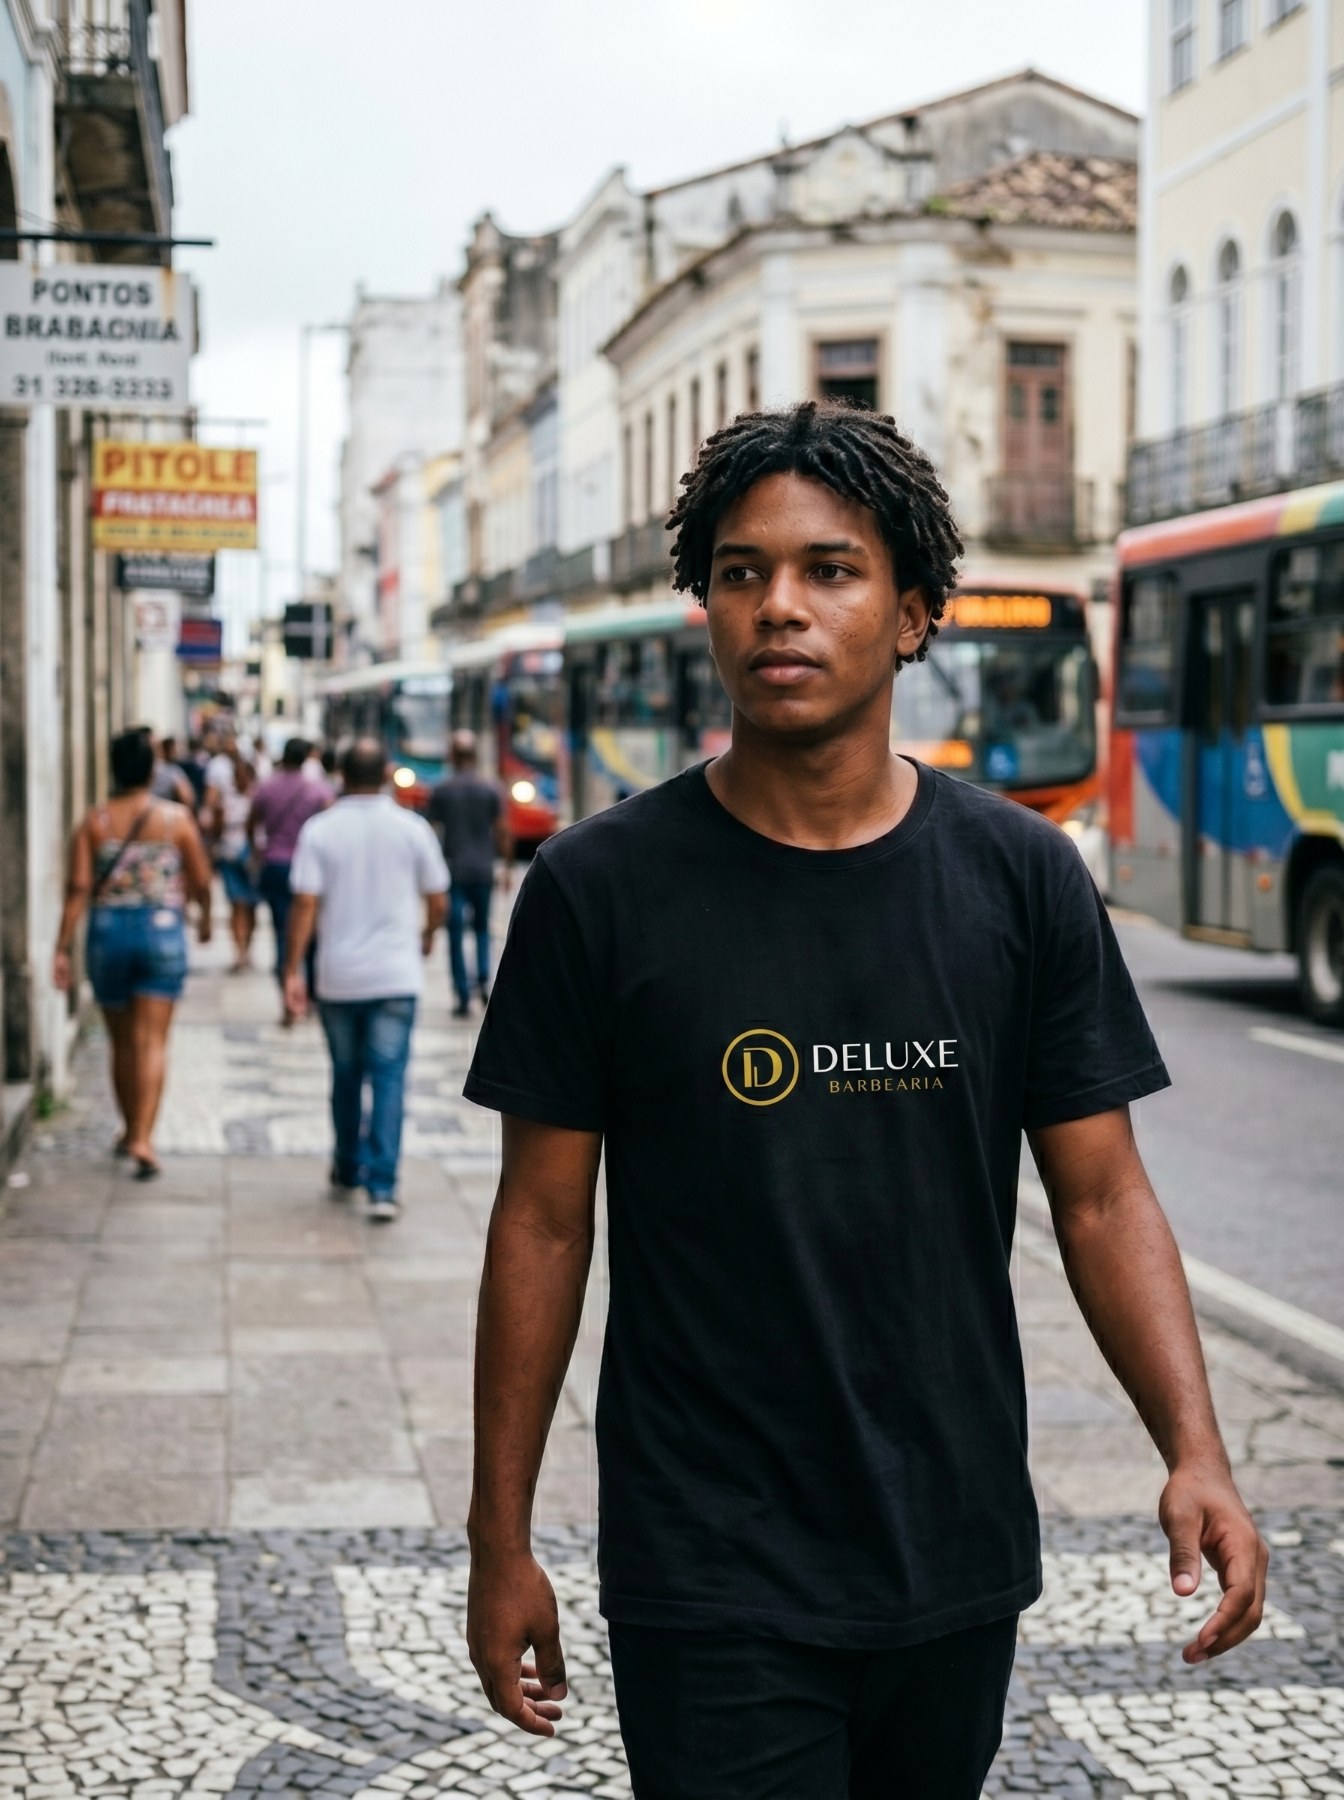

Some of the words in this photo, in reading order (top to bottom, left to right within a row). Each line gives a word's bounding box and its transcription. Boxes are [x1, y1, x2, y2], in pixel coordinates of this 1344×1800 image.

[32, 279, 152, 307] PONTOS
[103, 449, 250, 483] PITOLE
[812, 1039, 959, 1073] DELUXE
[829, 1076, 944, 1094] BARBEARIA
